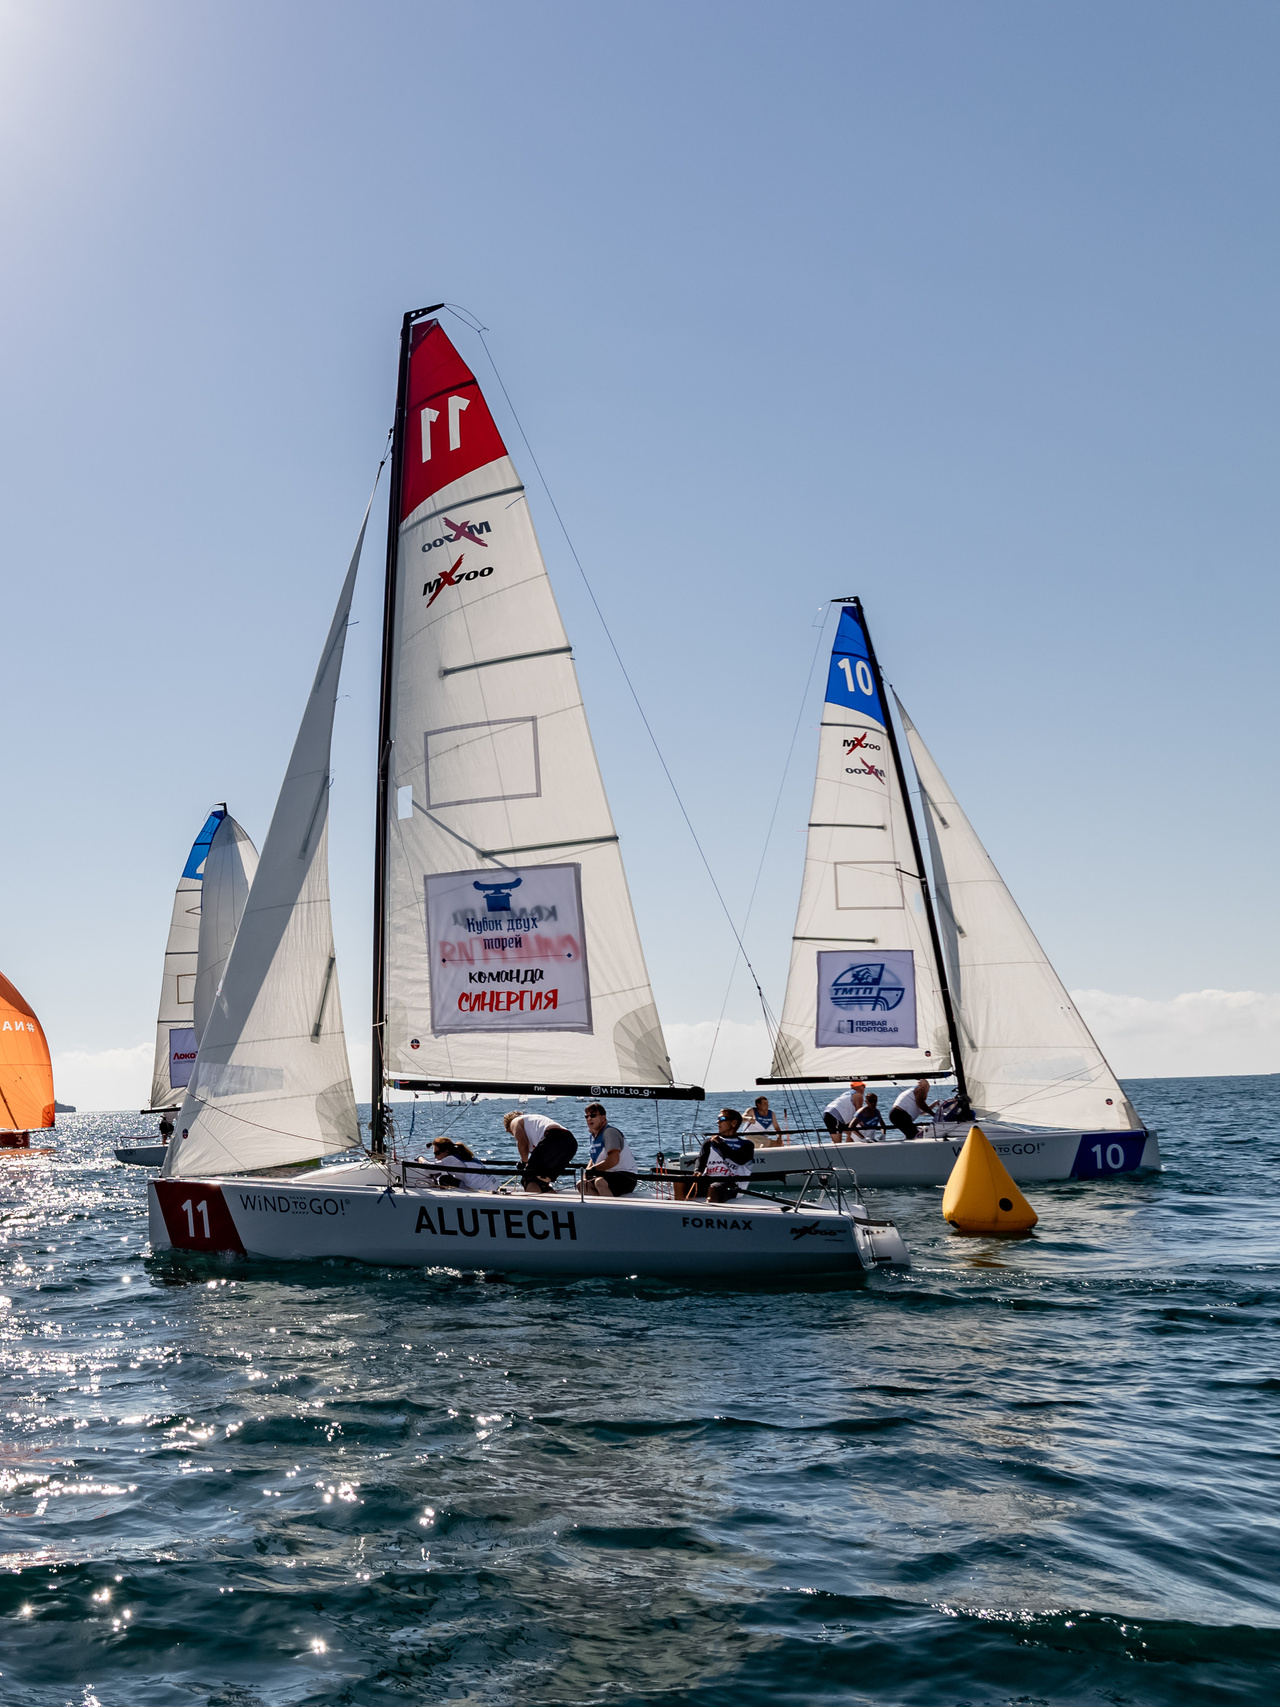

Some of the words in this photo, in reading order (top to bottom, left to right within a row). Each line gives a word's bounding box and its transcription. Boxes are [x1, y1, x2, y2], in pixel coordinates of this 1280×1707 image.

[422, 553, 494, 609] MX700
[837, 657, 874, 696] 10
[842, 731, 881, 756] MX700
[466, 917, 503, 934] Кубок
[506, 916, 538, 933] двух
[457, 988, 559, 1013] СИНЕРГИЯ
[16, 1134, 23, 1145] 3
[1091, 1143, 1125, 1170] 10
[292, 1201, 307, 1210] TO
[181, 1199, 211, 1238] 11
[415, 1206, 577, 1241] ALUTECH
[682, 1216, 753, 1231] FORNAX
